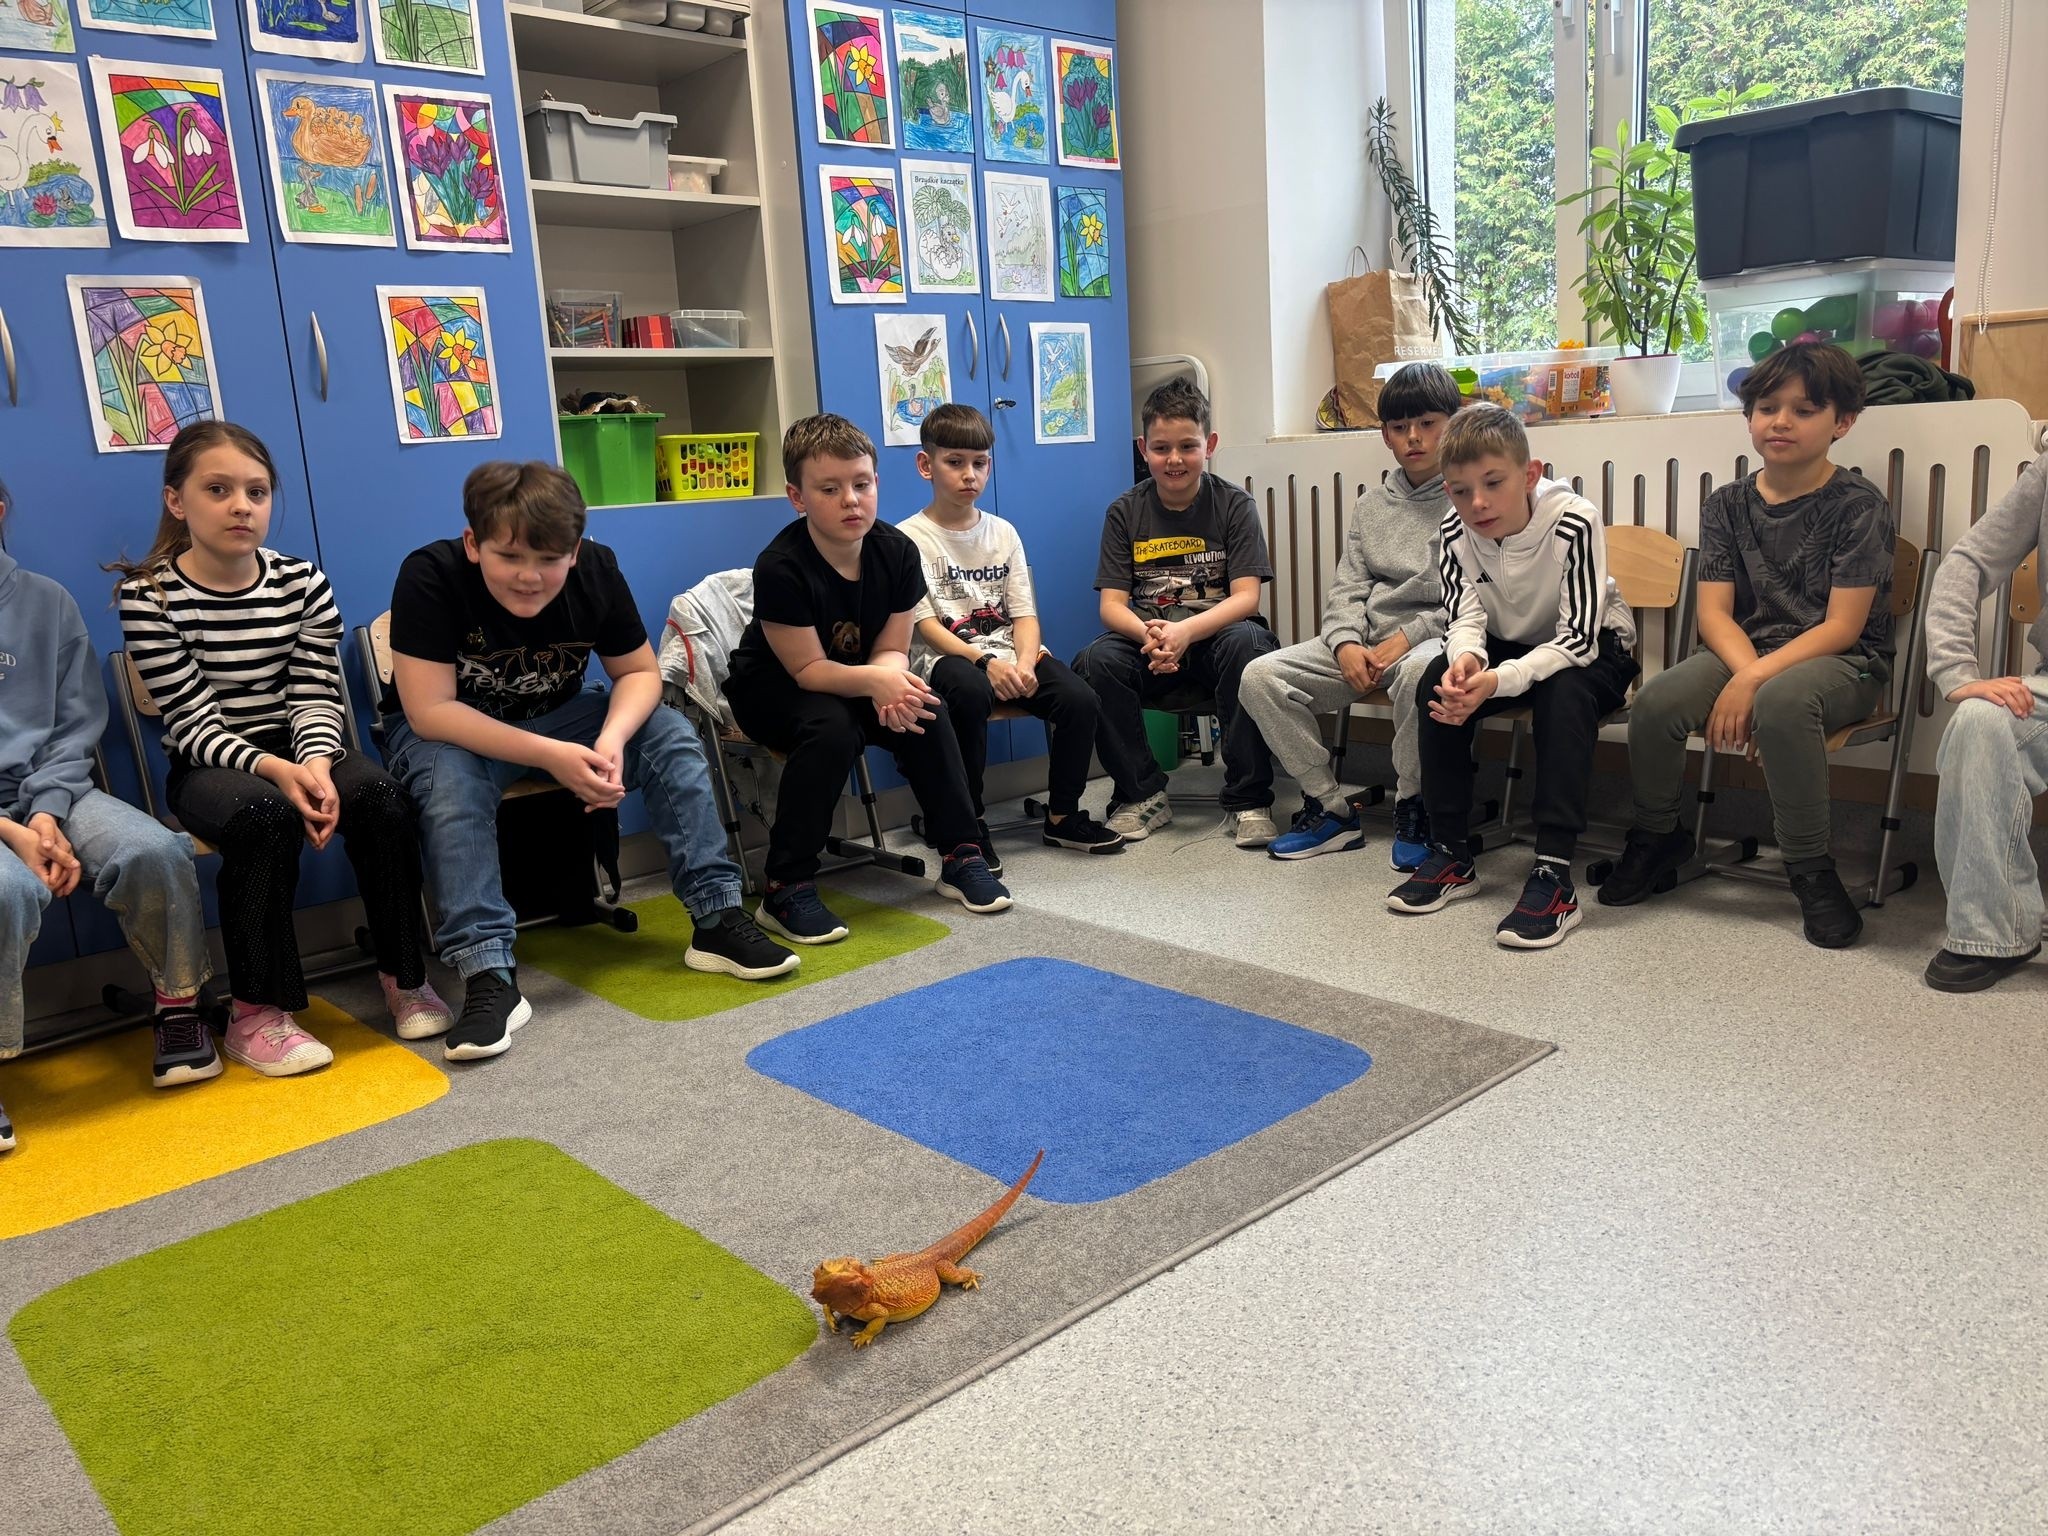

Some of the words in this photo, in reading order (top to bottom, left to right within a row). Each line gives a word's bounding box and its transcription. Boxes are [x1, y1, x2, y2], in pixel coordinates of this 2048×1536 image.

[1136, 545, 1148, 555] THE
[1148, 538, 1202, 553] SKATEBOARD
[1183, 549, 1227, 564] REVOLUTION
